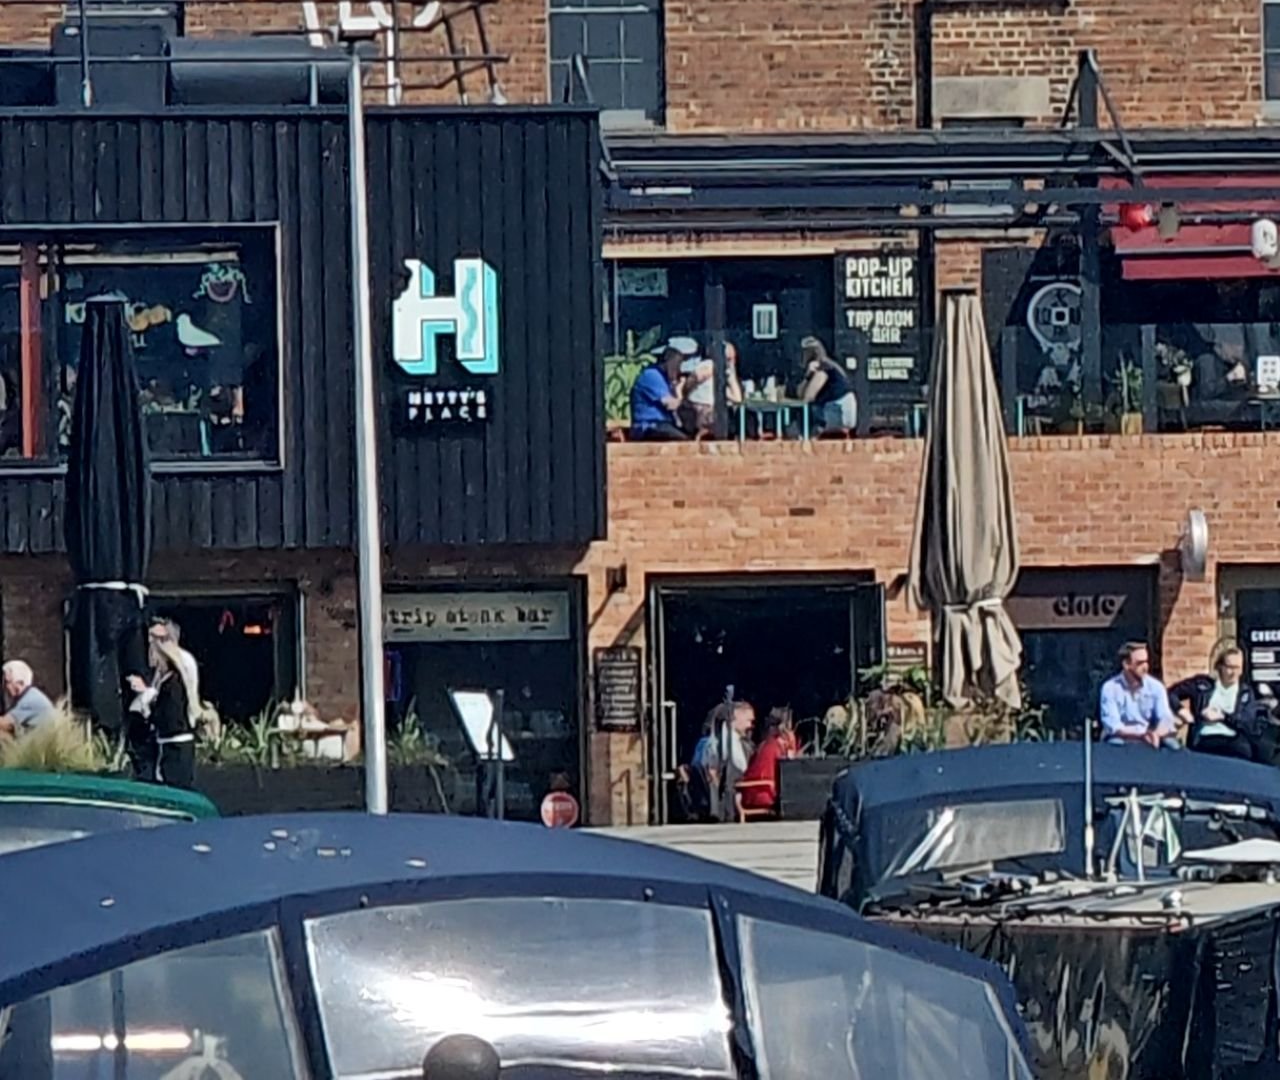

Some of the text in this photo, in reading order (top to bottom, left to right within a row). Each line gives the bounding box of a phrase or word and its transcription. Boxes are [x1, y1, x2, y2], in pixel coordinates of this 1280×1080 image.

[846, 257, 913, 278] POP-UP
[846, 277, 913, 298] KITCHEN
[382, 608, 436, 628] trip
